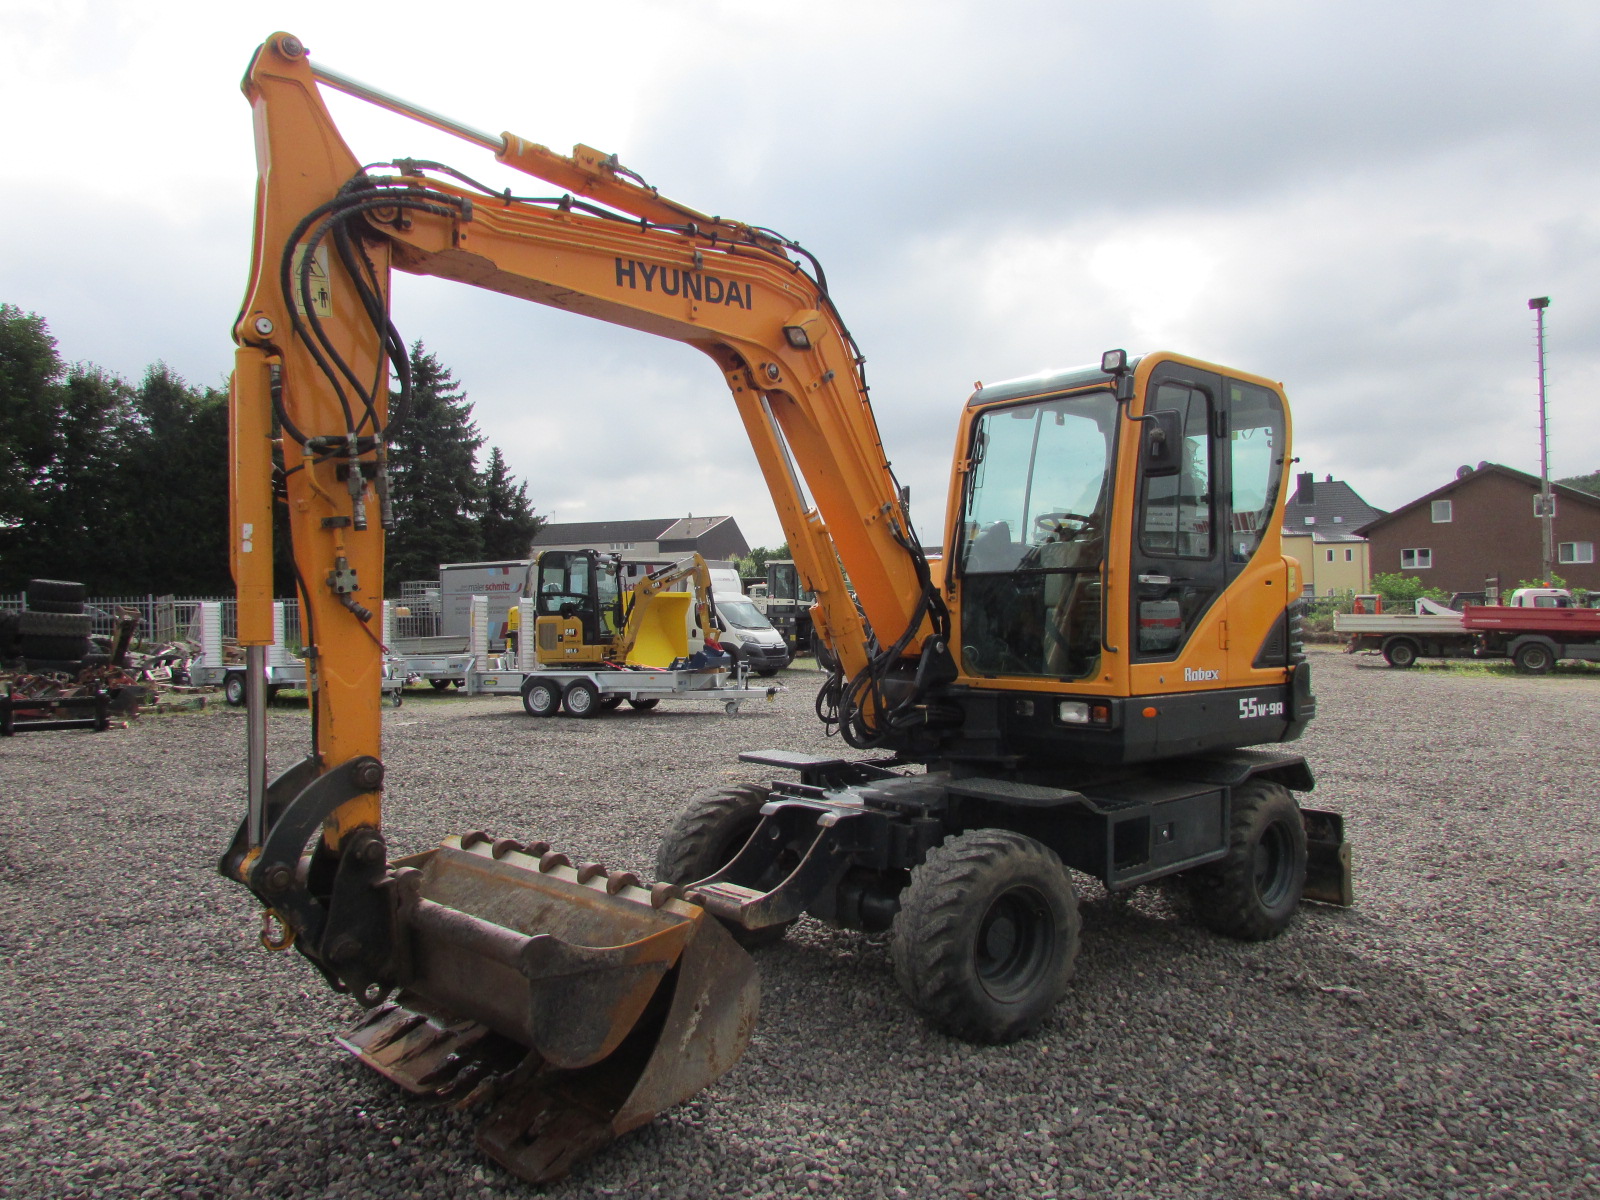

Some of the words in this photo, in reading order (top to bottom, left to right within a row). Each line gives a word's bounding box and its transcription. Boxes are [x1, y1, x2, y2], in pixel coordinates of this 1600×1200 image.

[615, 257, 752, 311] HYUNDAI
[564, 628, 576, 636] CAT
[1184, 667, 1219, 682] Robex
